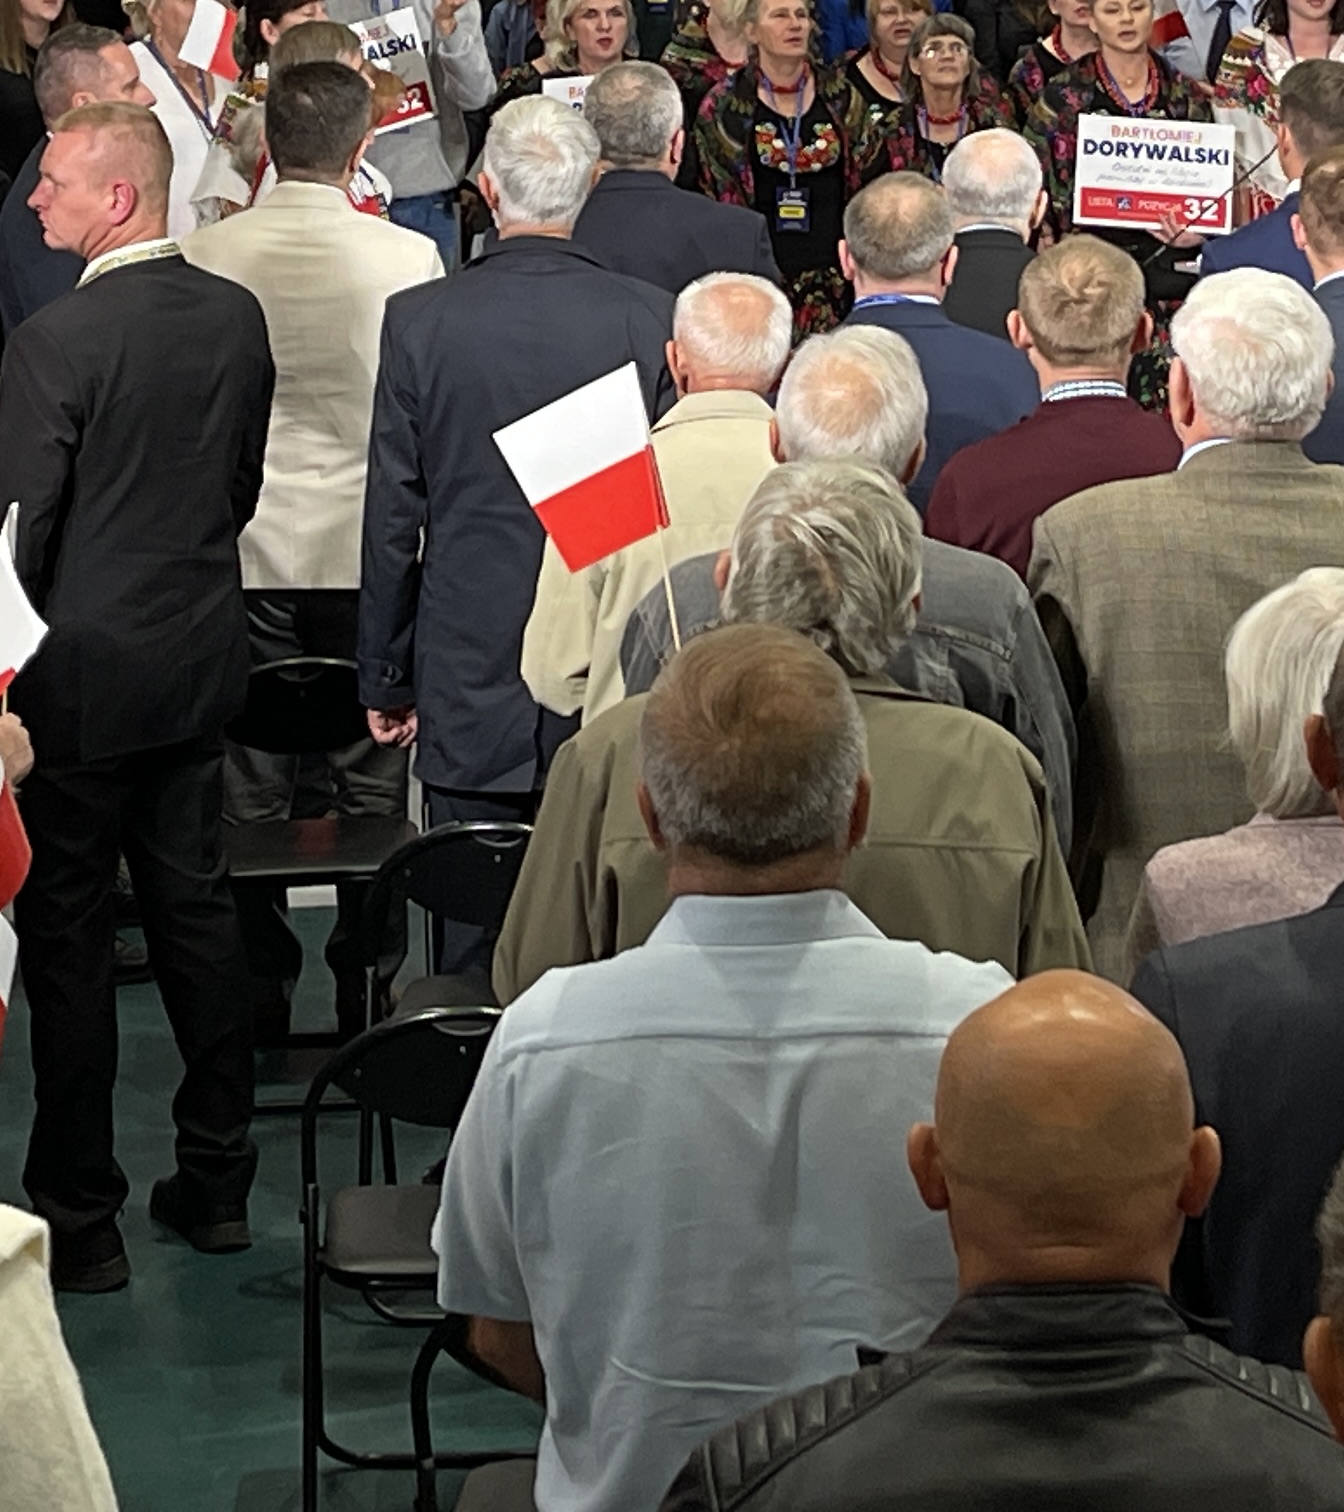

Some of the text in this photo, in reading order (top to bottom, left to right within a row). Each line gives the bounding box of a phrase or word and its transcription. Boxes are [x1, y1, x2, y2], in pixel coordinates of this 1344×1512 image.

[367, 33, 417, 61] ALSKI
[1110, 124, 1203, 145] BARTŁOMIEJ
[1083, 138, 1230, 166] DORYWALSKI
[1183, 198, 1219, 221] 32
